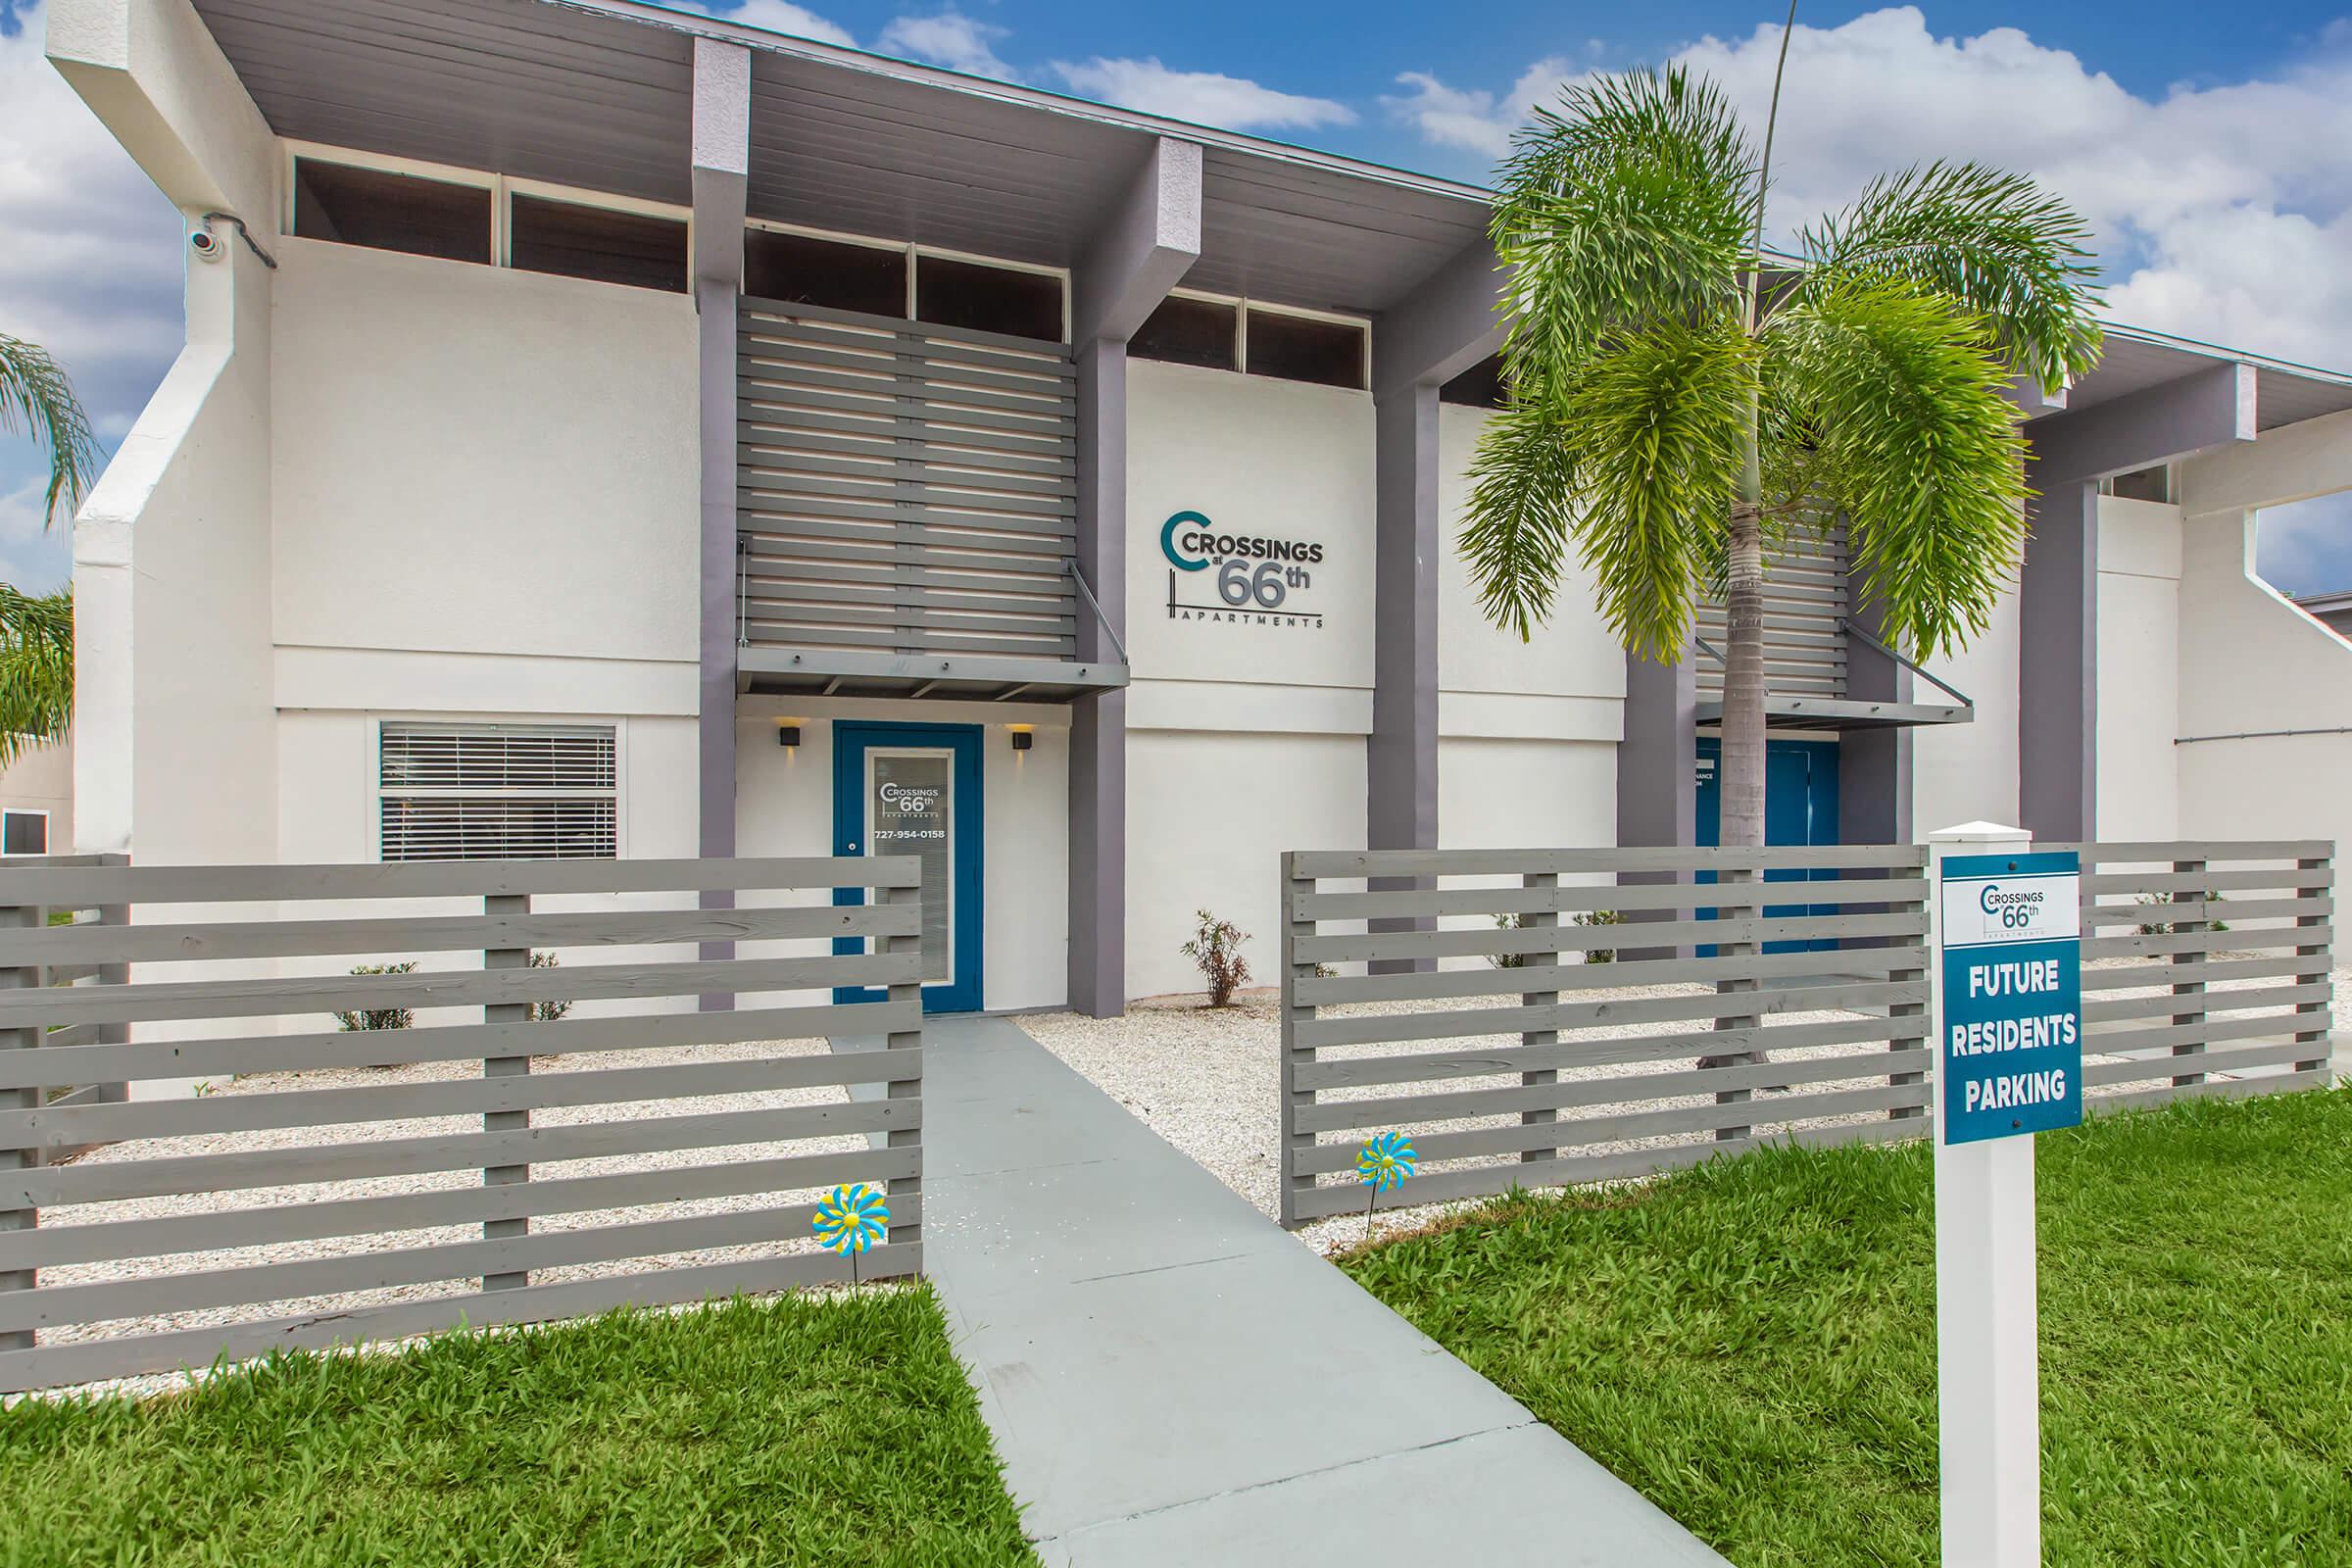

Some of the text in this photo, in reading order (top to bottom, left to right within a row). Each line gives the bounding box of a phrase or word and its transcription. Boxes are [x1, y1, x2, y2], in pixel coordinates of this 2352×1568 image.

[1182, 532, 1324, 564] CROSSINGS
[1218, 559, 1310, 609] 66th
[1182, 611, 1323, 629] APARTMENTS
[875, 830, 945, 839] 727-954-0158
[1987, 892, 2044, 906] CROSSINGS
[1969, 959, 2060, 999] FUTURE
[1952, 1012, 2077, 1057] RESIDENTS
[1965, 1069, 2066, 1113] PARKING
